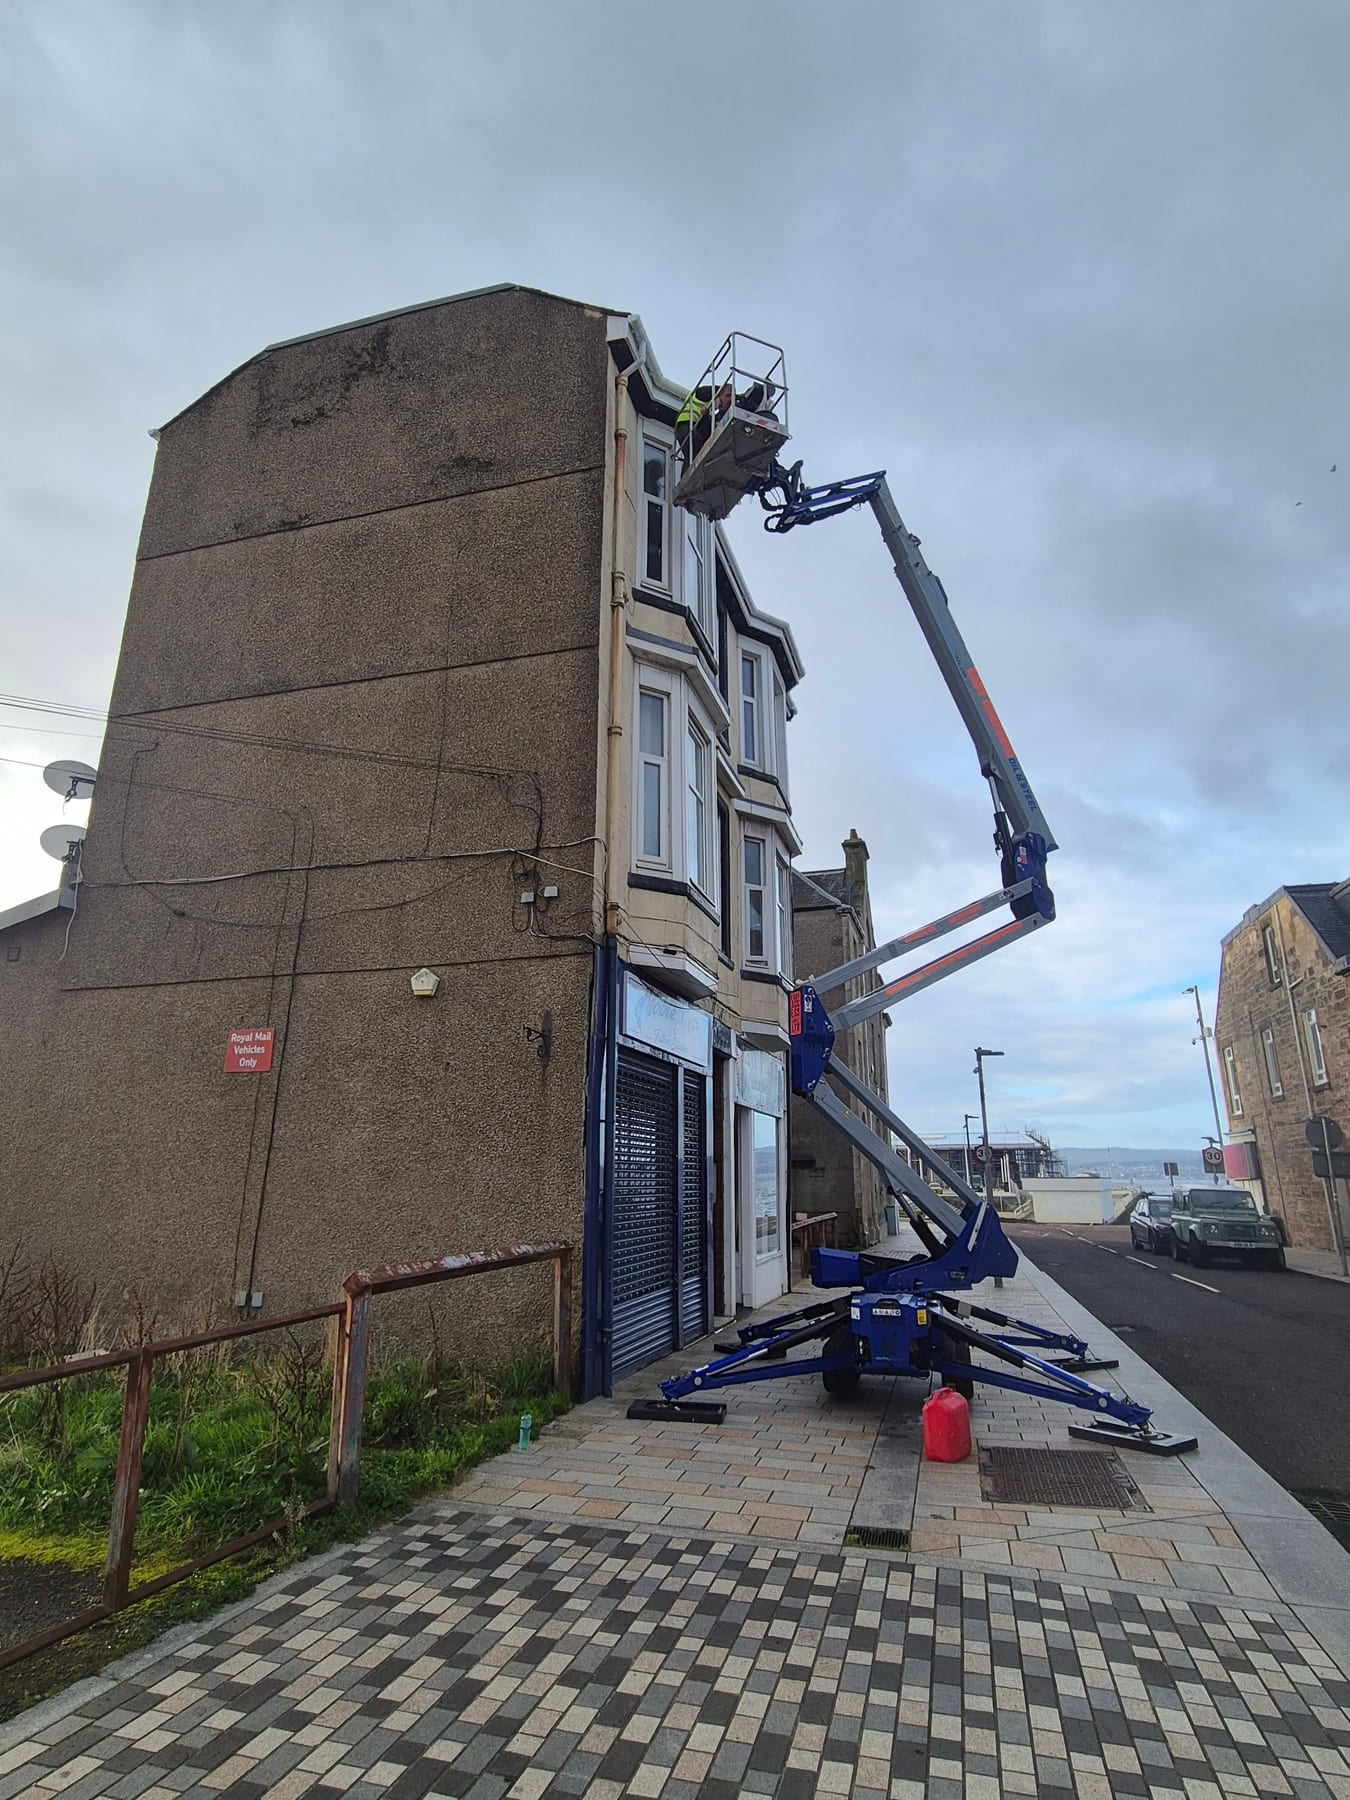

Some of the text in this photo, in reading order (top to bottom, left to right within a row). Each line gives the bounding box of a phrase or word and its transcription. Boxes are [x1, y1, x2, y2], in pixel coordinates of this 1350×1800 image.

[231, 1031, 272, 1044] Royal Mail
[234, 1045, 265, 1055] Vehicles
[239, 1057, 257, 1068] Only
[1206, 1151, 1221, 1160] 30
